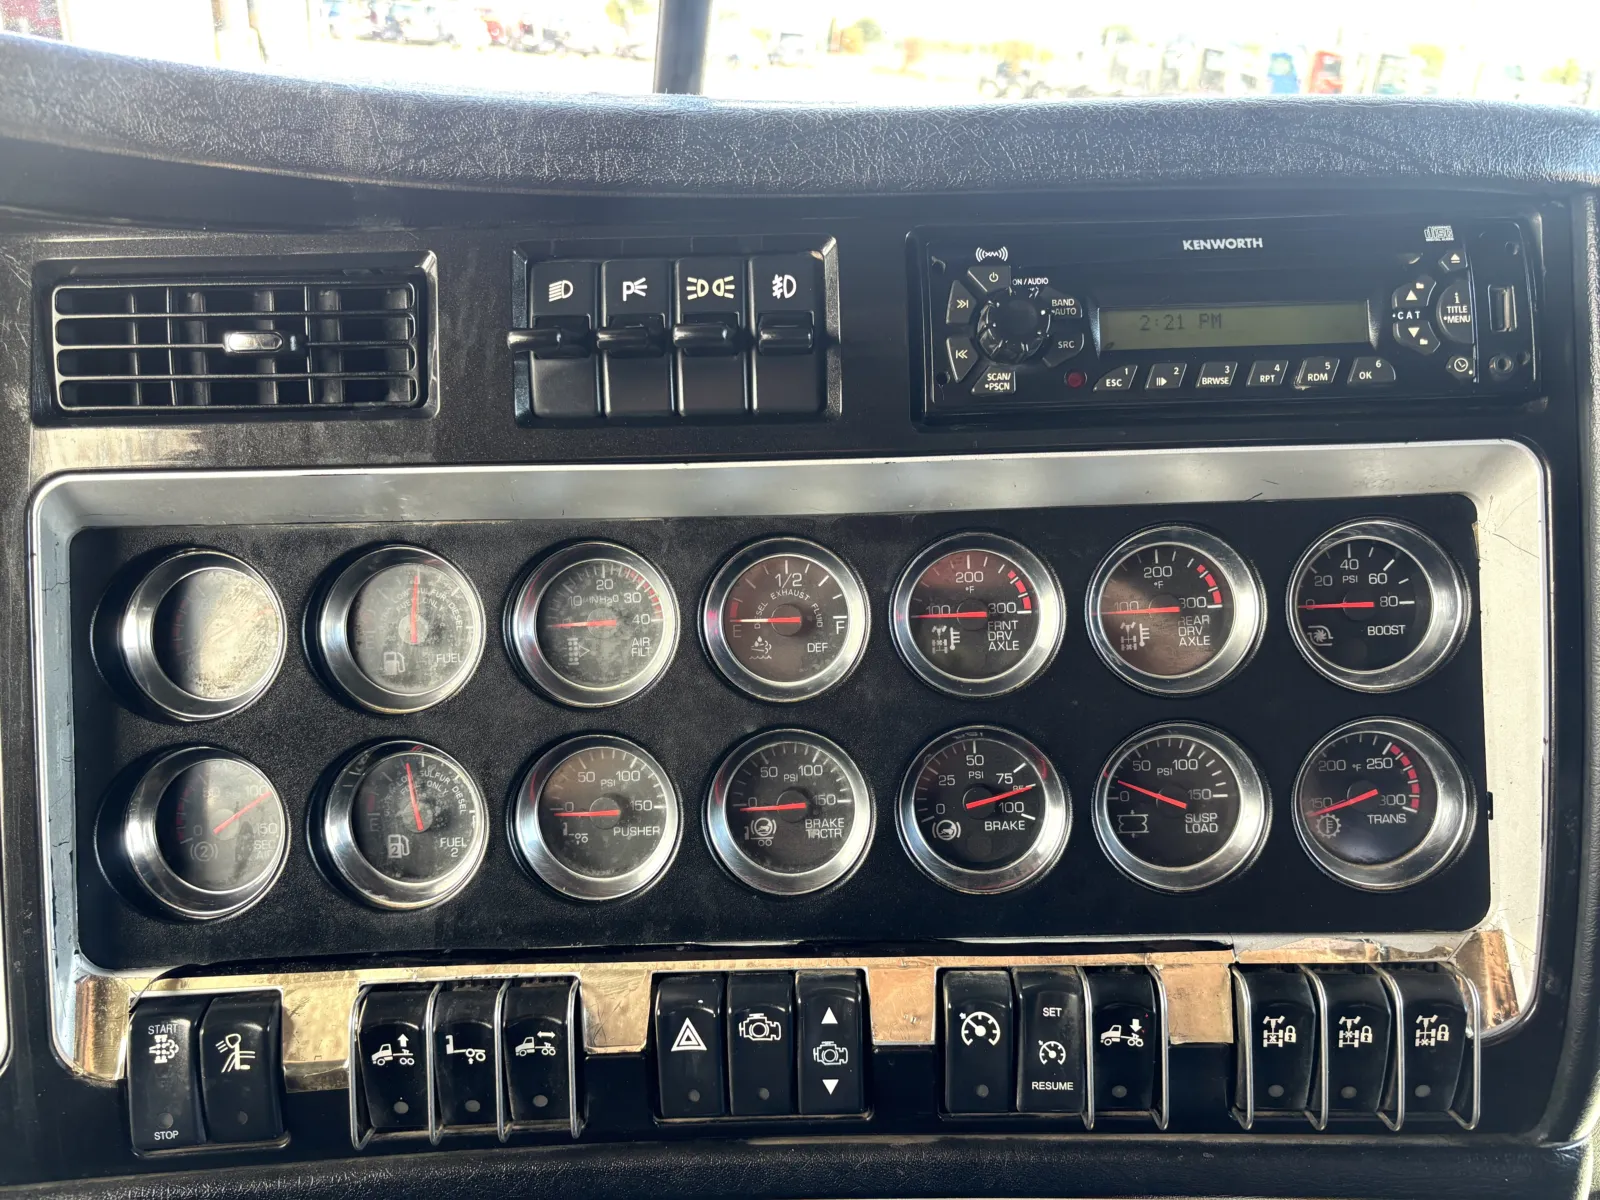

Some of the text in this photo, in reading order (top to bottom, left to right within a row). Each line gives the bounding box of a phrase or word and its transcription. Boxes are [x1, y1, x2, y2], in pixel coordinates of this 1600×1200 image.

[1182, 237, 1264, 251] KENWORTH
[1052, 298, 1075, 307] BAND
[1446, 305, 1468, 314] TITLE
[1139, 313, 1223, 331] 2:21 PM
[1057, 340, 1075, 349] SRC
[1224, 366, 1231, 374] 3
[1274, 364, 1281, 373] 4
[1324, 362, 1331, 371] 5
[1375, 360, 1382, 369] 6
[986, 372, 1011, 382] SCAN/
[1124, 368, 1129, 376] 1
[1173, 367, 1180, 376] 2
[1307, 372, 1329, 382] RDM
[1358, 371, 1373, 380] OK
[1105, 378, 1123, 388] ESC
[1201, 376, 1230, 386] BRWSE
[1260, 374, 1276, 384] RPT
[1340, 559, 1359, 571] 40
[956, 571, 984, 583] 200
[1143, 565, 1173, 578] 200
[596, 579, 614, 590] 20
[774, 572, 803, 588] 1/2
[1314, 575, 1333, 587] 20
[1342, 575, 1358, 584] PSI
[1368, 573, 1388, 585] 60
[568, 595, 582, 607] 10
[624, 592, 642, 604] 30
[1179, 596, 1207, 609] 300
[1380, 595, 1398, 608] 80
[770, 589, 811, 601] EXHAUST
[811, 602, 823, 628] FLUID
[926, 605, 951, 615] 100
[988, 602, 1017, 614] 300
[1114, 601, 1139, 612] 100
[1305, 599, 1315, 611] 0
[448, 602, 463, 632] DIESEL
[632, 614, 651, 625] 40
[1178, 615, 1210, 626] REAR
[732, 624, 742, 638] E
[836, 620, 845, 635] F
[988, 620, 1018, 631] FRNT
[1367, 624, 1406, 636] BOOST
[988, 631, 1013, 641] DRV
[1178, 626, 1203, 637] DRV
[632, 637, 650, 647] AIR
[988, 640, 1020, 651] AXLE
[1179, 636, 1211, 647] AXLE
[632, 648, 652, 657] FILT
[807, 643, 828, 653] DEF
[436, 652, 463, 664] FUEL
[966, 755, 984, 766] 50
[1132, 760, 1151, 771] 50
[1172, 759, 1198, 771] 100
[1318, 760, 1346, 771] 200
[1366, 758, 1393, 769] 250
[760, 766, 778, 778] 50
[798, 764, 823, 776] 100
[968, 771, 984, 779] PSI
[1156, 768, 1173, 776] PSI
[578, 772, 596, 783] 50
[616, 770, 640, 782] 100
[783, 774, 799, 782] PSI
[938, 774, 956, 786] 25
[996, 773, 1014, 784] 75
[426, 780, 449, 794] ONLY
[600, 779, 616, 787] PSI
[420, 771, 450, 785] SULFUR
[451, 785, 467, 816] DIESEL
[1120, 791, 1130, 802] 0
[1188, 788, 1212, 800] 150
[630, 800, 653, 811] 150
[748, 797, 758, 808] 0
[813, 794, 836, 806] 150
[1380, 794, 1406, 806] 300
[564, 802, 574, 813] 0
[936, 803, 946, 814] 0
[999, 801, 1024, 813] 100
[805, 818, 845, 829] BRAKE
[1185, 813, 1218, 823] SUSP
[1367, 814, 1406, 824] TRANS
[193, 825, 202, 836] 0
[370, 818, 379, 832] E
[984, 821, 1026, 831] BRAKE
[1185, 823, 1218, 834] LOAD
[613, 826, 660, 837] PUSHER
[439, 837, 468, 848] FUEL
[451, 848, 459, 858] 2
[1042, 1007, 1062, 1017] SET
[148, 1023, 178, 1035] START
[1031, 1081, 1074, 1091] RESUME
[154, 1130, 179, 1141] STOP
